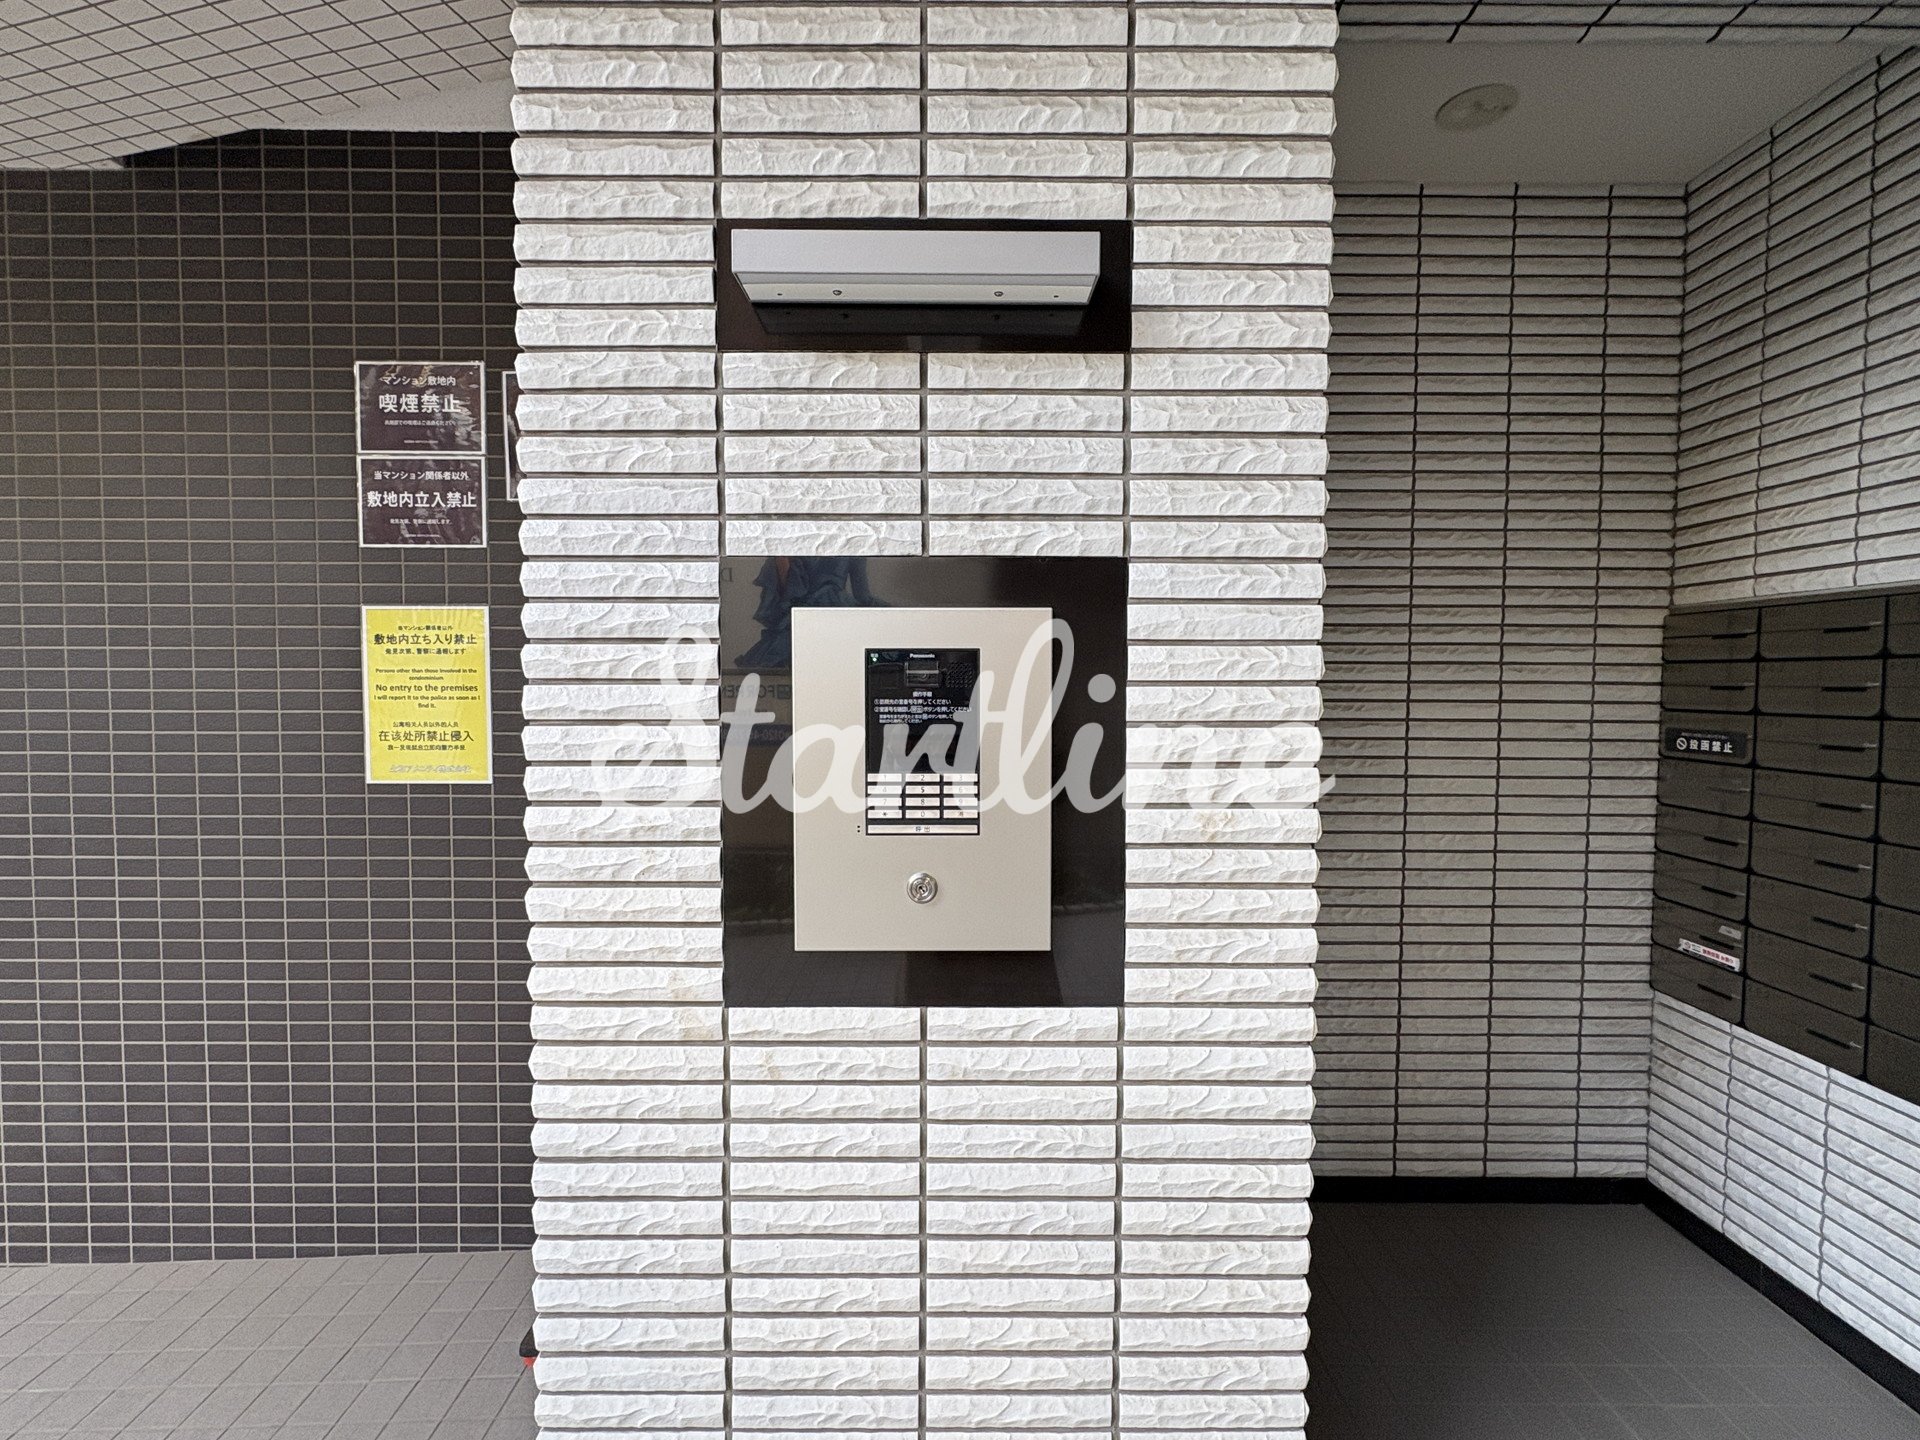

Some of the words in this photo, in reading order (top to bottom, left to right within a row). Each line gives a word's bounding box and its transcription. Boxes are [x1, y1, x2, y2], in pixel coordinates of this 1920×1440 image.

[383, 376, 456, 386] マンション敷地内
[378, 393, 461, 414] 喫煙禁止
[374, 470, 469, 480] 当マンション関係者以外
[366, 490, 477, 508] 敷地内立入禁止
[374, 634, 477, 645] 敷地内立ち入り禁止
[376, 684, 388, 692] No
[390, 685, 411, 693] entry
[414, 684, 422, 692] to
[424, 684, 438, 692] the
[441, 684, 478, 693] premises
[379, 730, 474, 742] 在该处所禁止侵入
